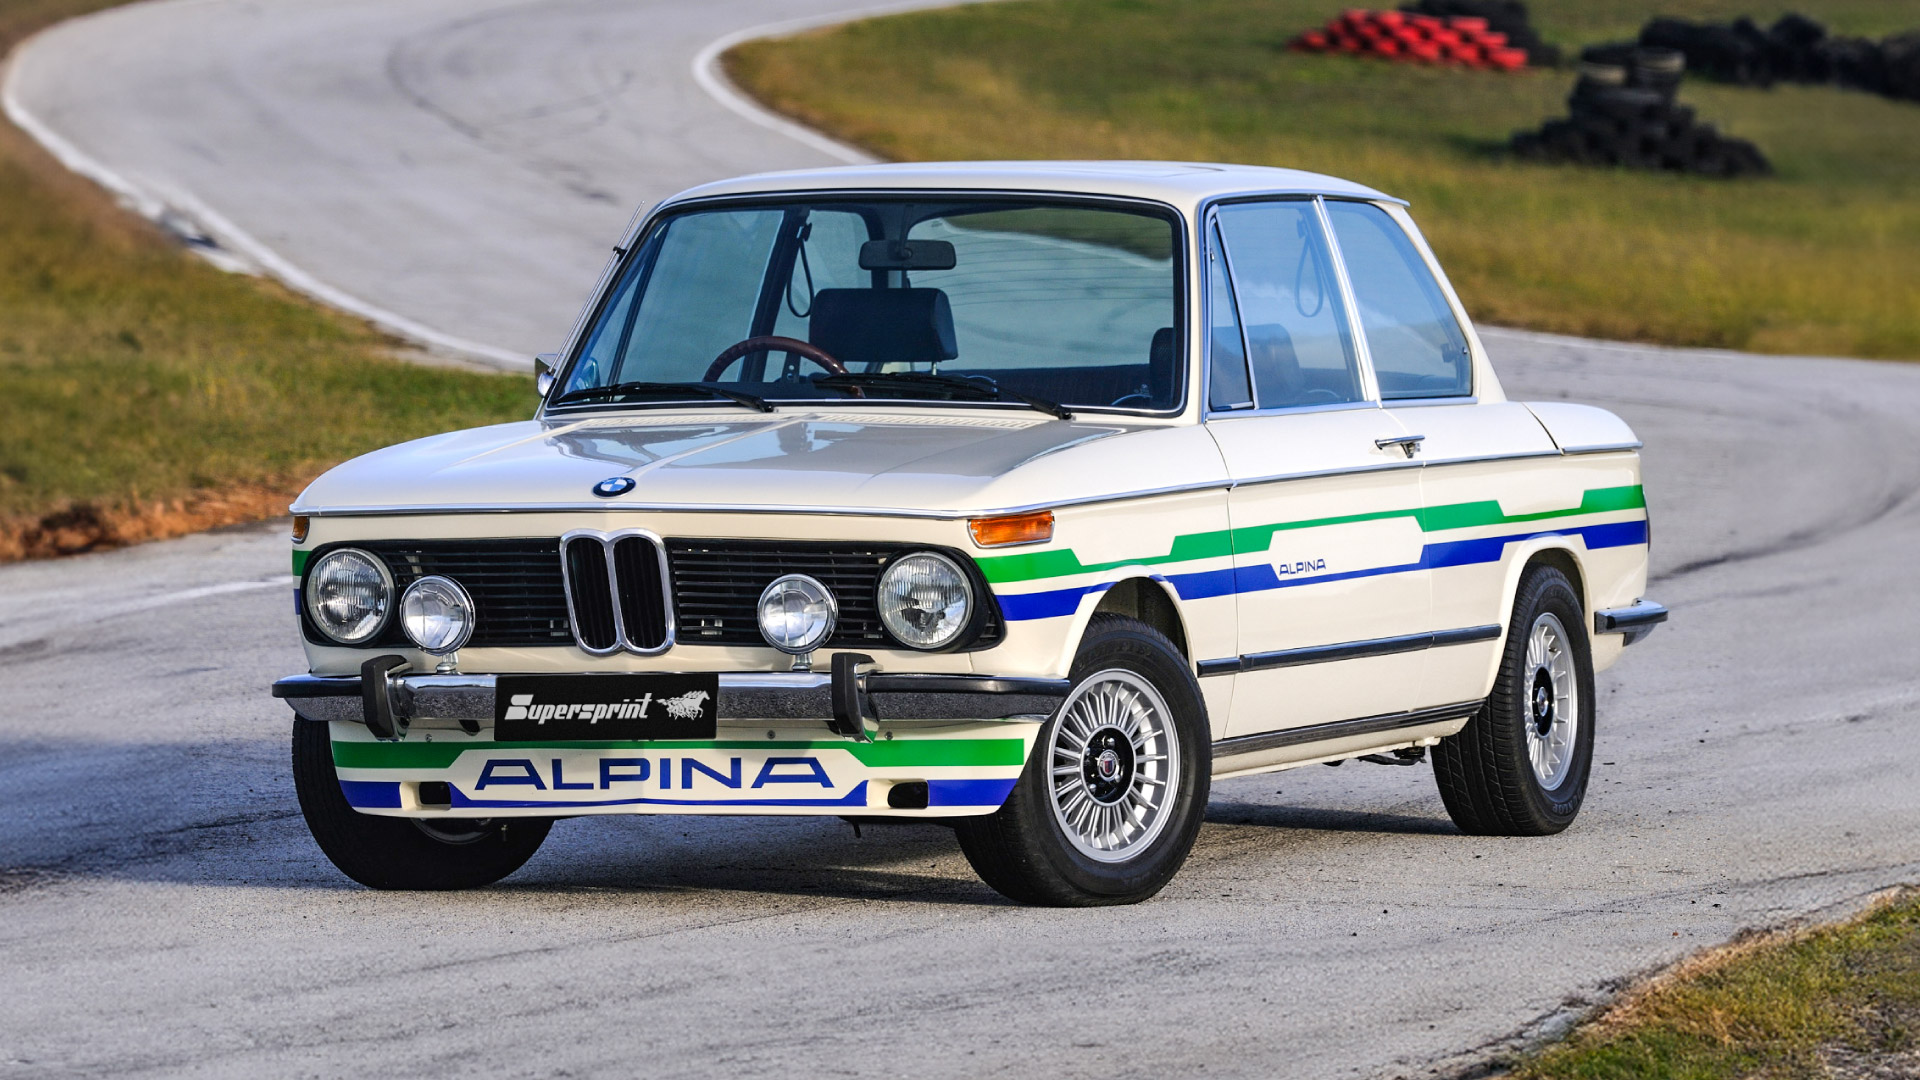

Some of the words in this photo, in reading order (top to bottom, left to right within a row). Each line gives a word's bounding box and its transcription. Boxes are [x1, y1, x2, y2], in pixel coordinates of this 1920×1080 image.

[1279, 558, 1327, 576] ALPINA
[504, 692, 653, 725] Supersprint
[475, 757, 835, 791] ALPINA
